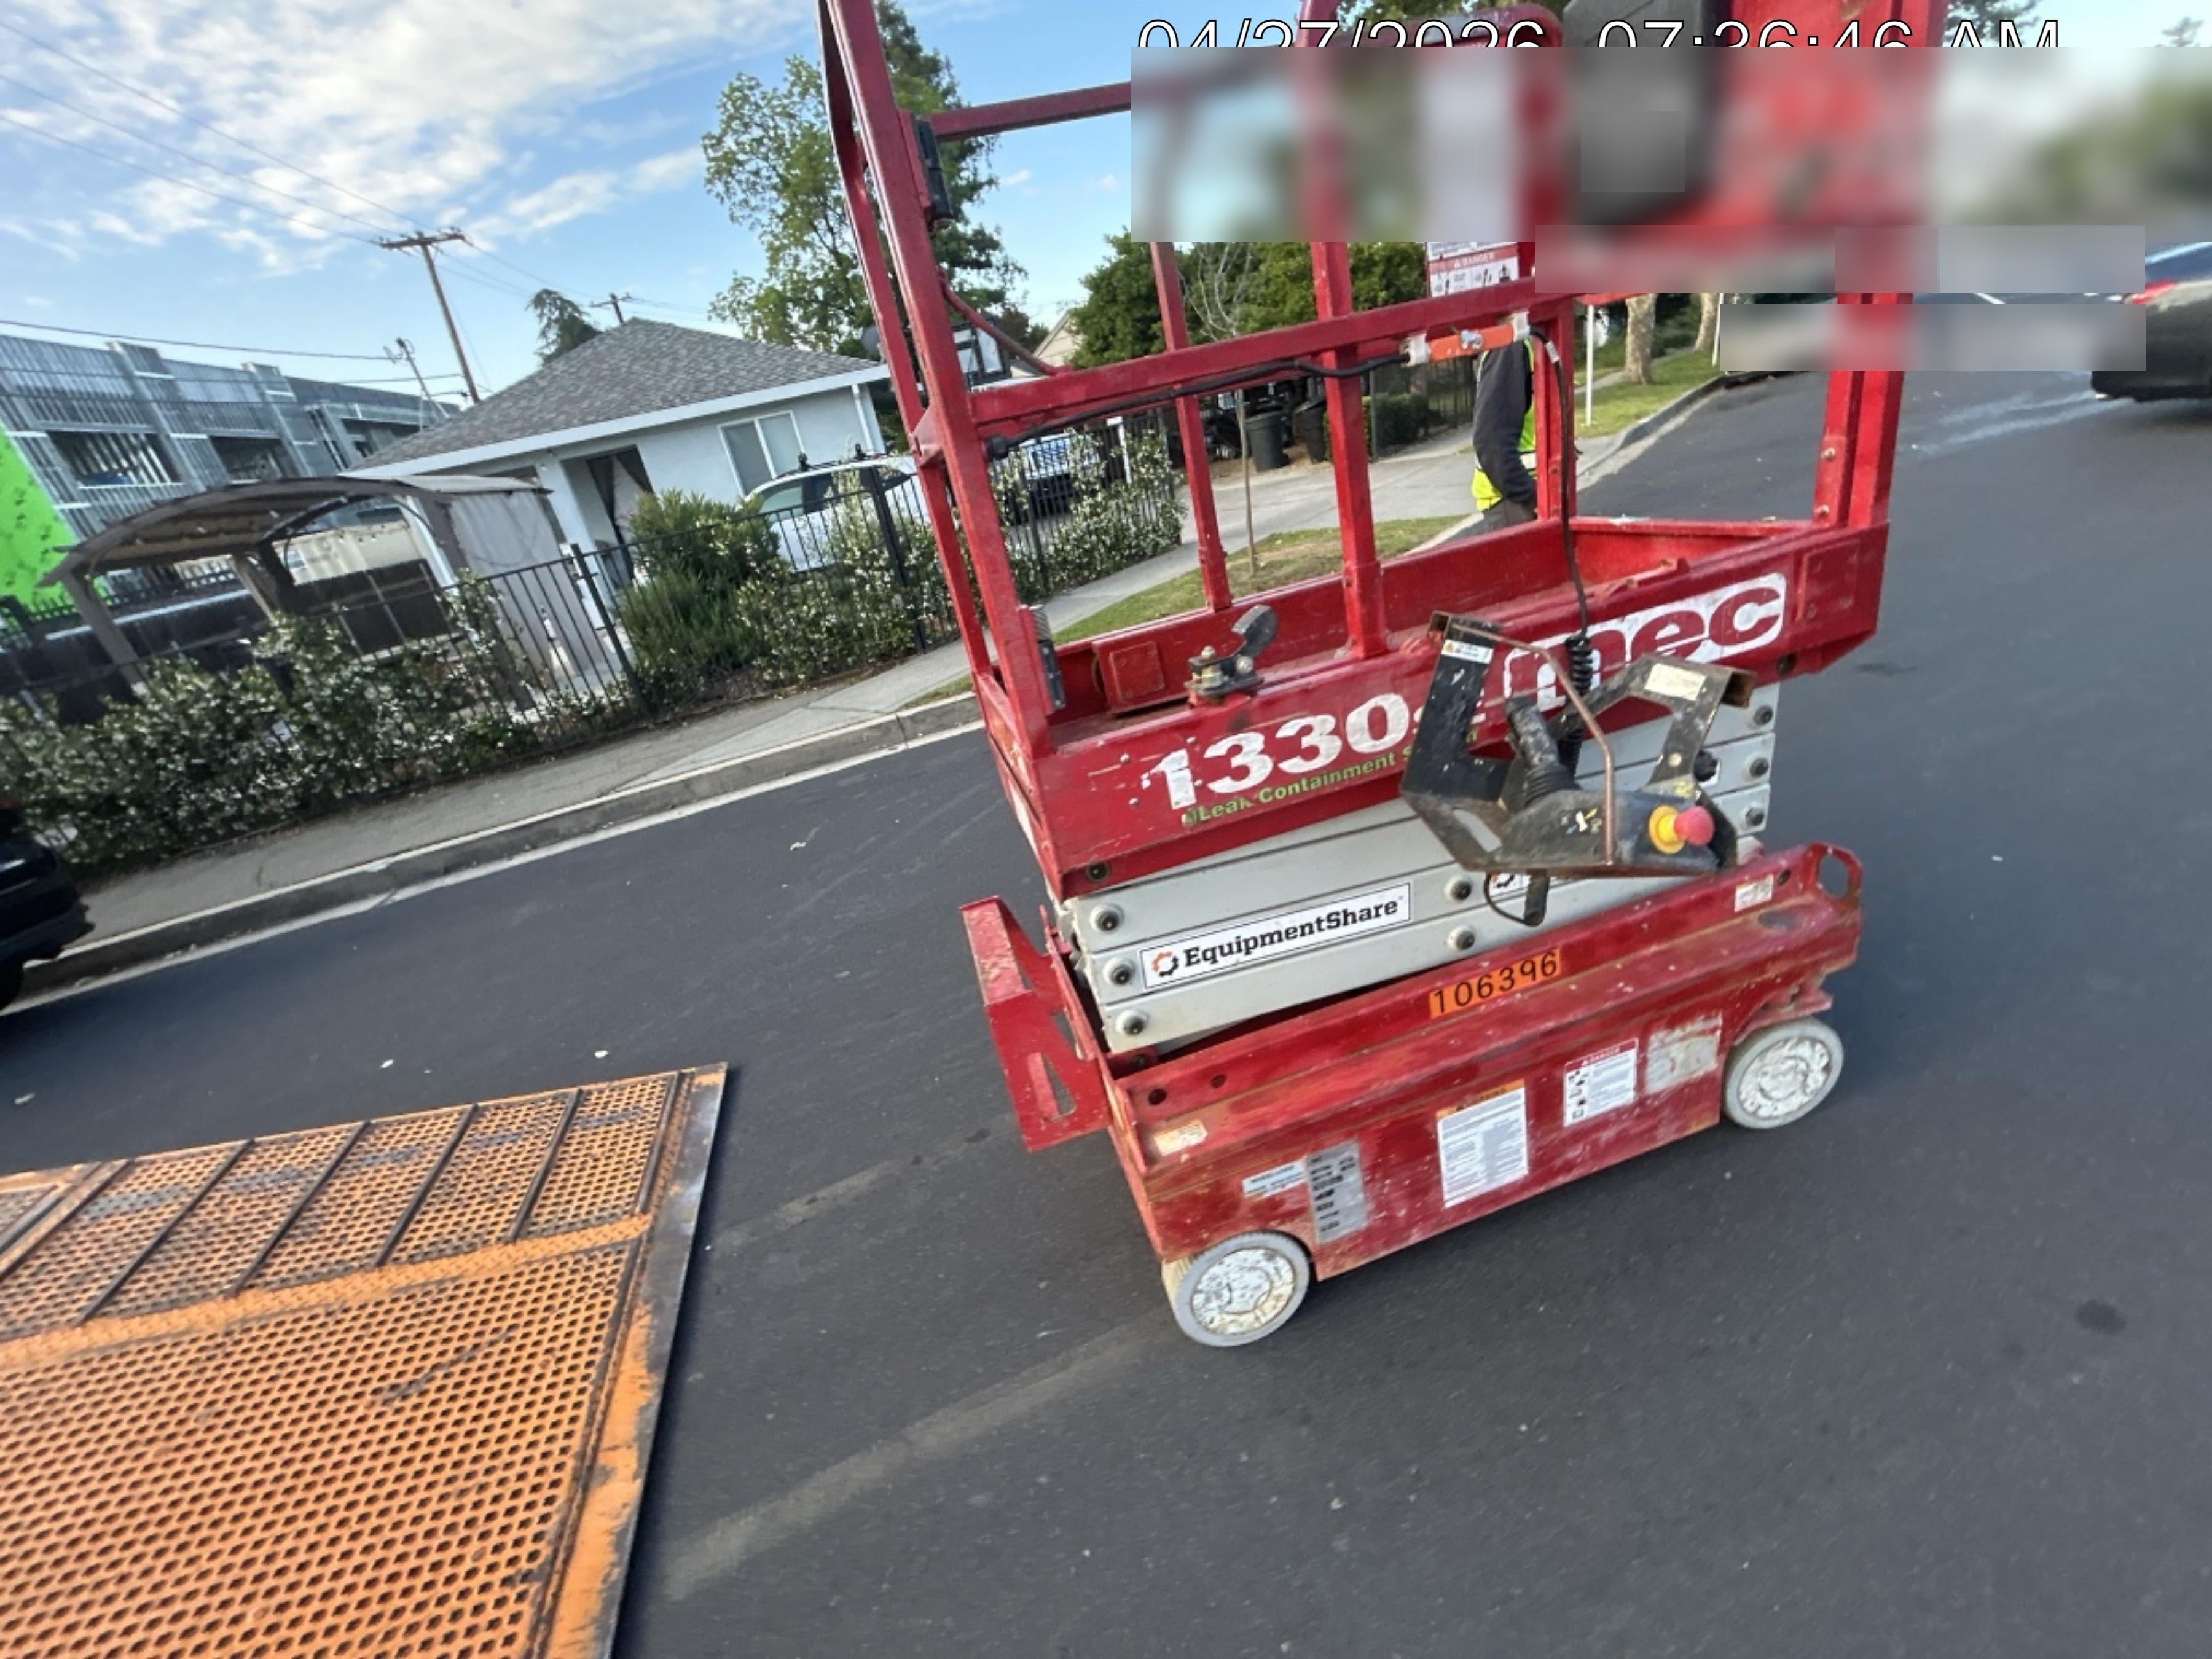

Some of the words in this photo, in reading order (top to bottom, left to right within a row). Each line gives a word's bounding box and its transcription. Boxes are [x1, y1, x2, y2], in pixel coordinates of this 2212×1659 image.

[1141, 692, 1424, 810] 1330
[1199, 796, 1253, 822] Leak
[1257, 751, 1396, 803] Containment
[1183, 900, 1398, 968] EquipmentShare
[1434, 950, 1557, 1013] 106396
